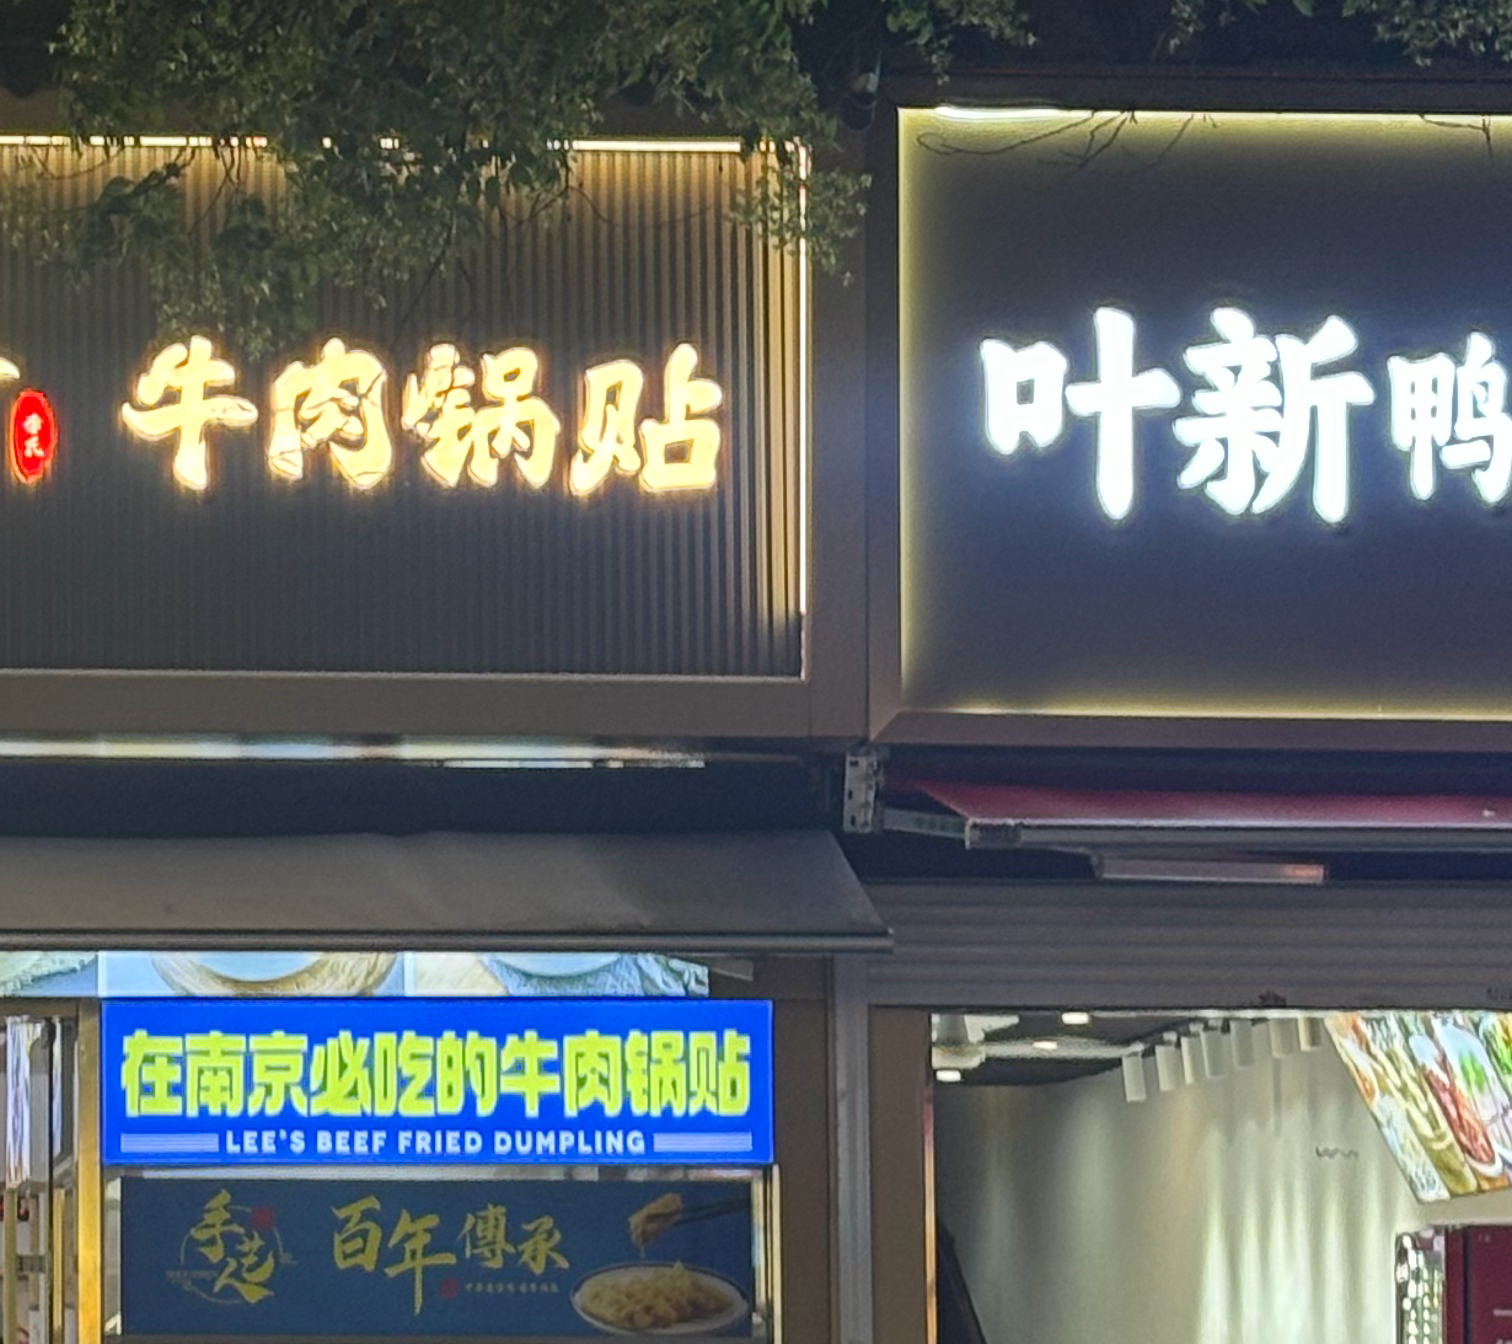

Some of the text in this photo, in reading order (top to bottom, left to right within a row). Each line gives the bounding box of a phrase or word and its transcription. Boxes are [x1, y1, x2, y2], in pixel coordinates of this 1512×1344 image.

[122, 336, 722, 496] 牛肉锅贴
[120, 1029, 752, 1119] 在南京必吃的牛肉锅贴
[226, 1130, 646, 1156] LEE'S BEEF FRIED DUMPLING
